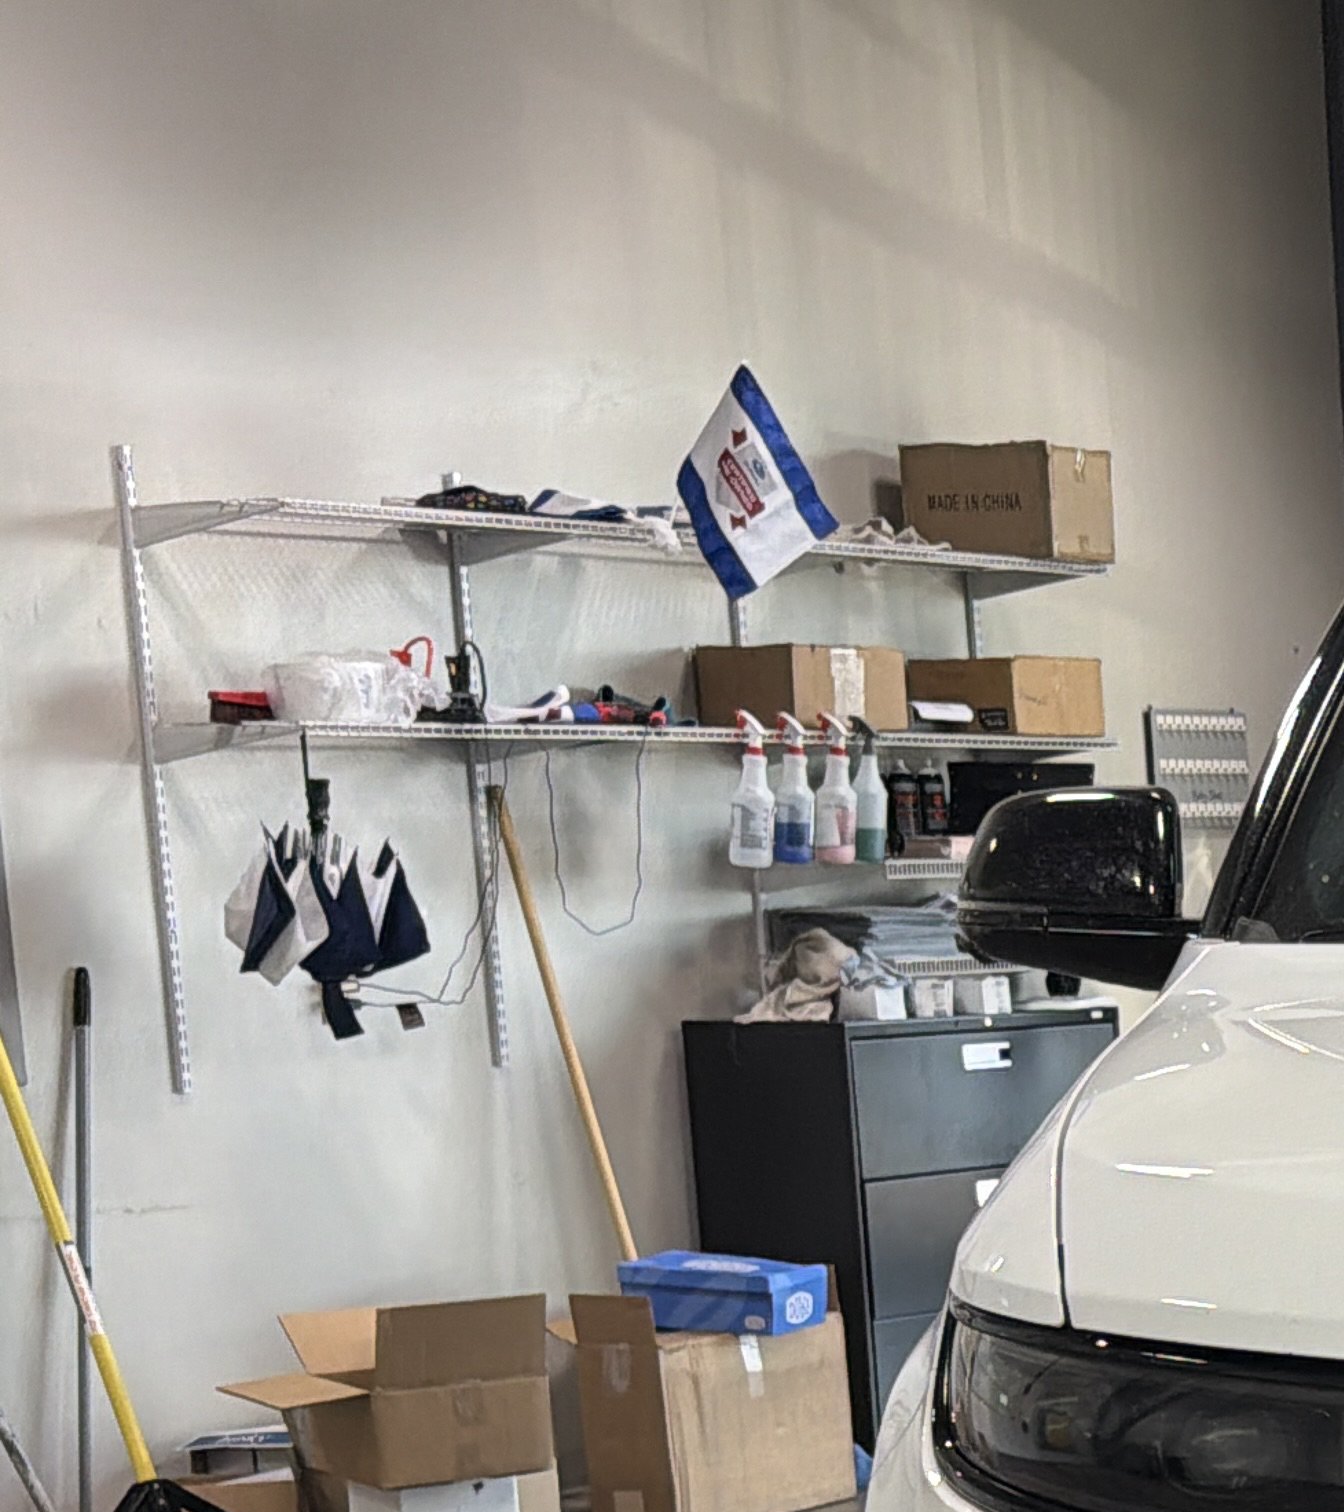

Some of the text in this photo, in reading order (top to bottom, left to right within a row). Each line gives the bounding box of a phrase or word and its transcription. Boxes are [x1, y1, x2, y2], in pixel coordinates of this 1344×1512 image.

[927, 492, 1022, 511] MADE IN CHINA
